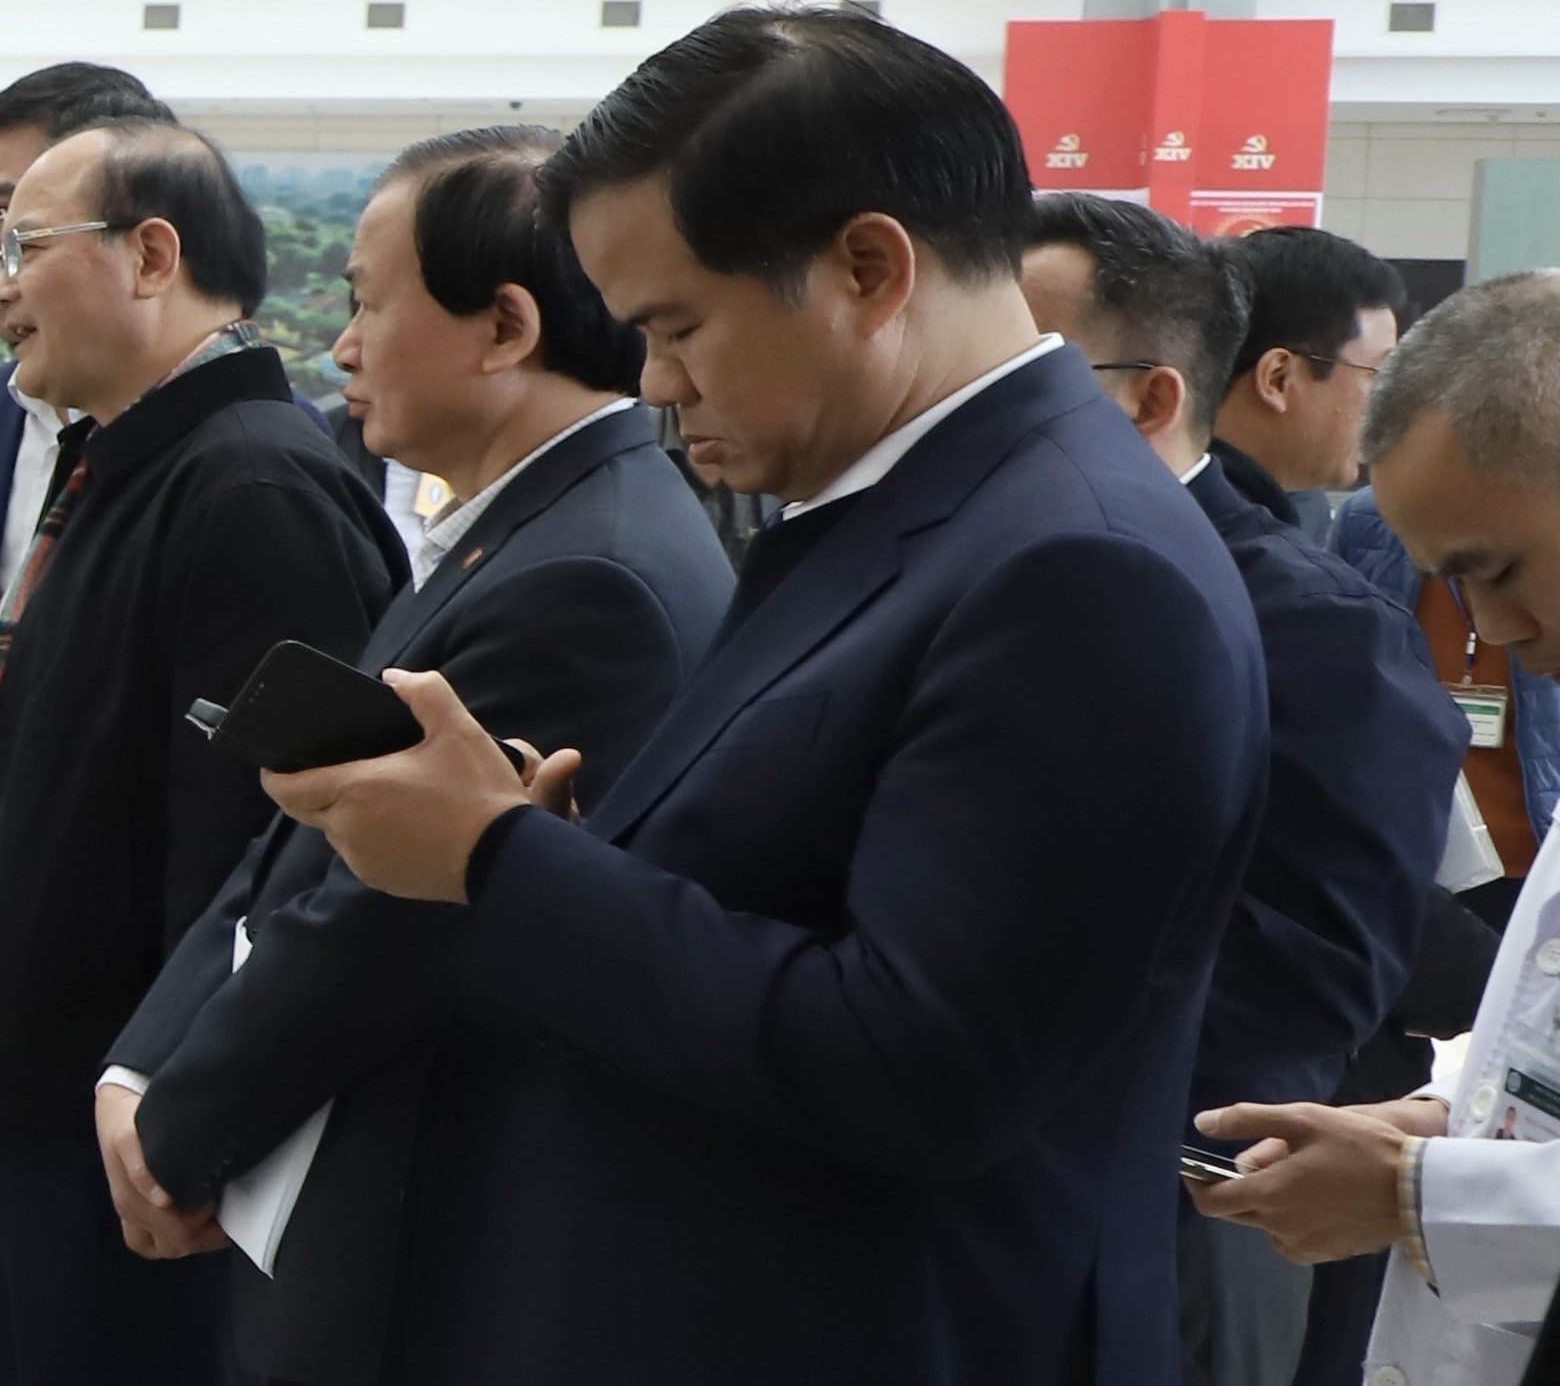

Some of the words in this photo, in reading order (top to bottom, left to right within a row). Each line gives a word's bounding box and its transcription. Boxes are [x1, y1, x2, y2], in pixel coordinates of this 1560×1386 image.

[1045, 152, 1089, 168] XIV
[1153, 147, 1192, 161] XIV
[1231, 154, 1276, 170] XIV
